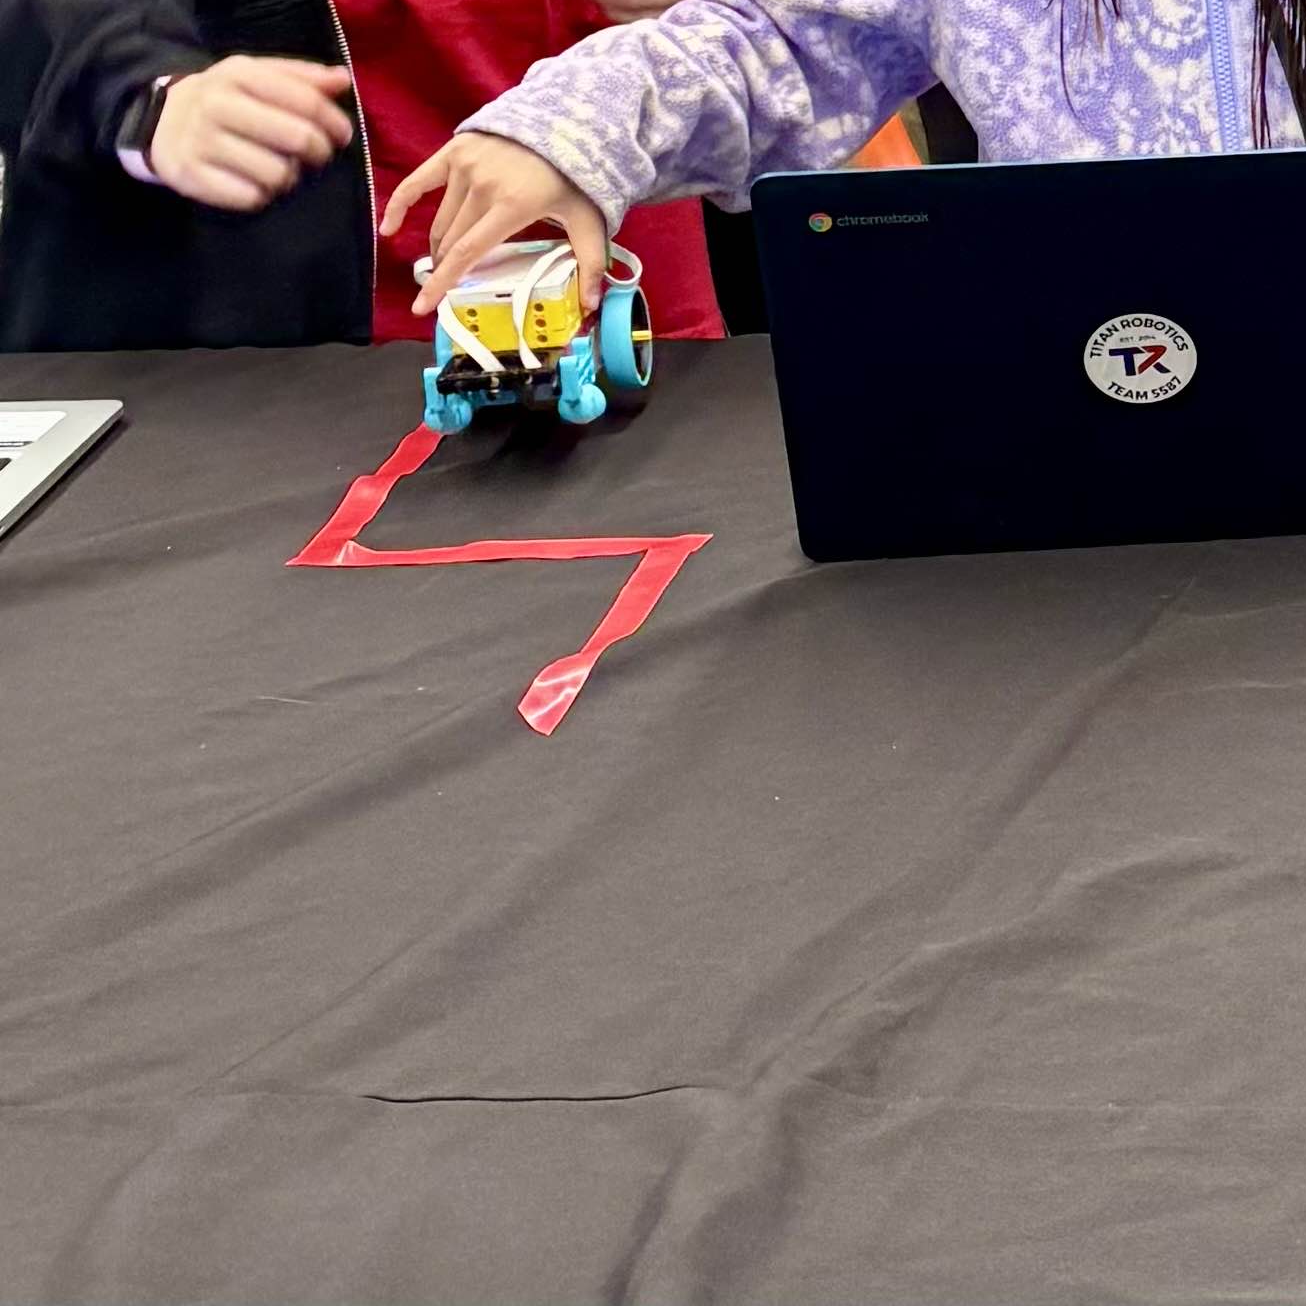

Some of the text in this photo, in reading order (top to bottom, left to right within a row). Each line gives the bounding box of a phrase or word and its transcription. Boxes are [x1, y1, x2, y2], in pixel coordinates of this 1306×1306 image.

[837, 212, 929, 227] chromebook
[1090, 317, 1189, 359] TITAN ROBOTICS
[1107, 375, 1182, 400] TEAM 5587
